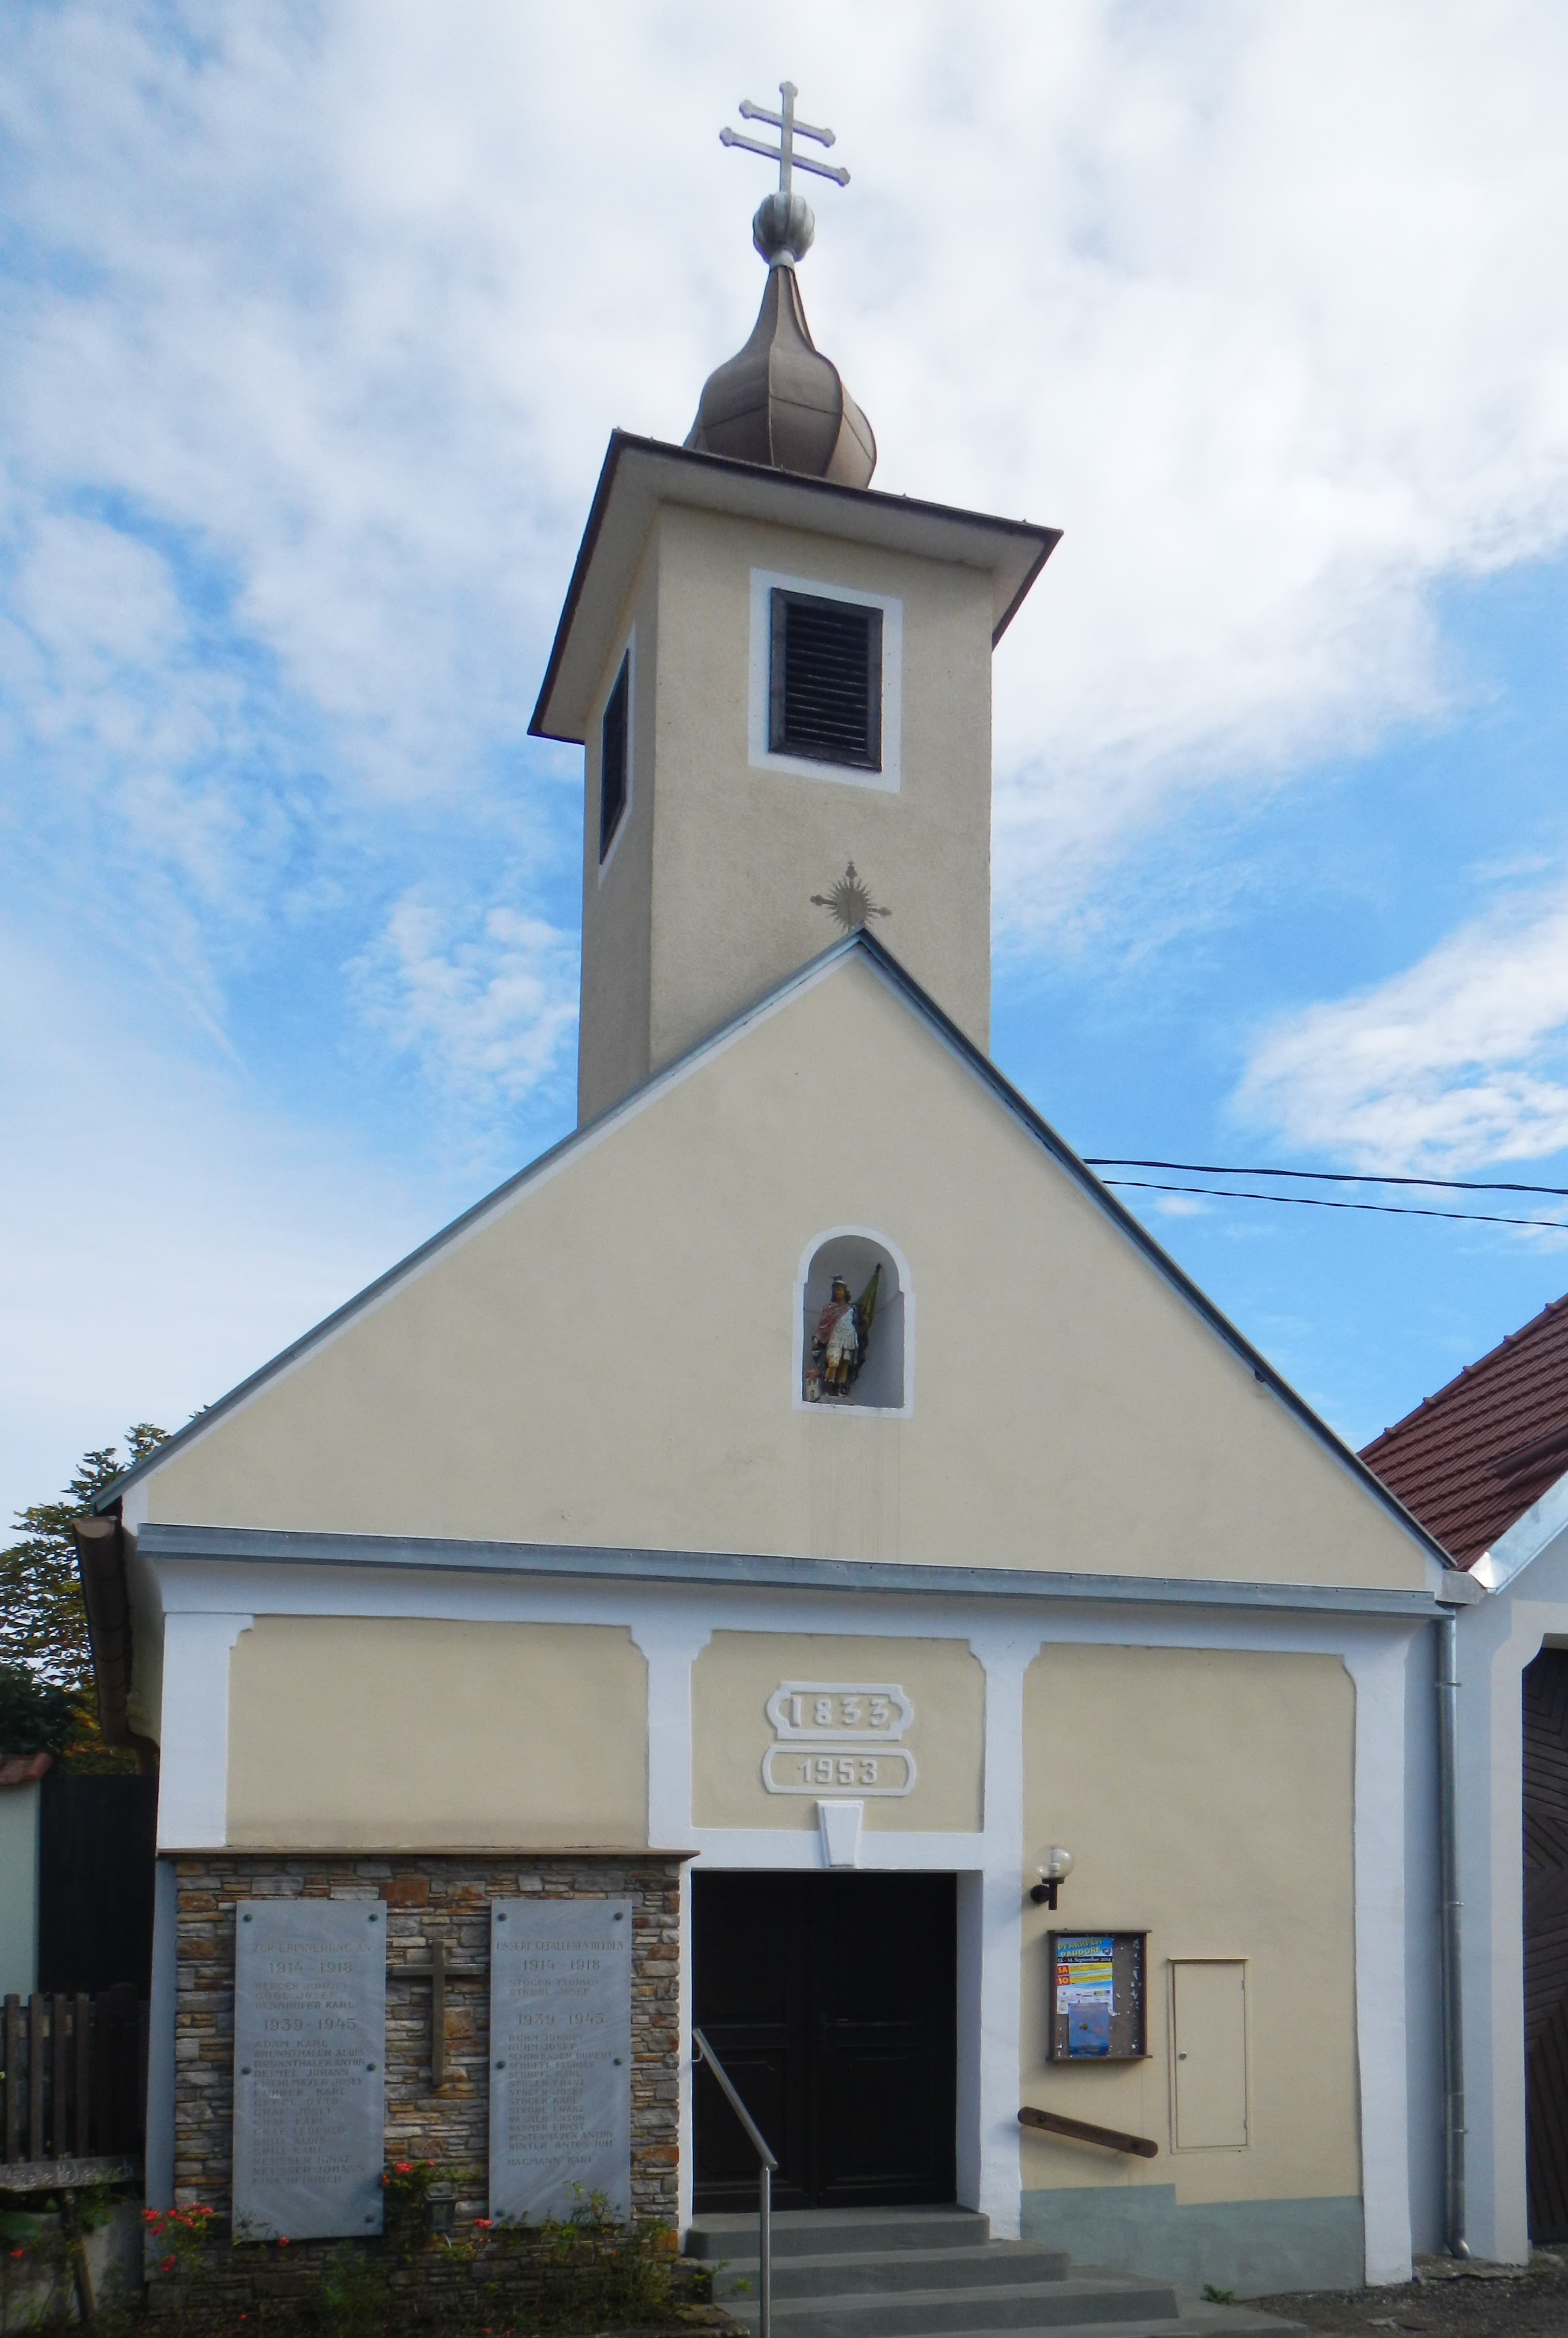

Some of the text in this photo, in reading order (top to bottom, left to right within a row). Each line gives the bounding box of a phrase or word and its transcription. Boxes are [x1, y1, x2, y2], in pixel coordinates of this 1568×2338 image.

[790, 1695, 890, 1727] 1833
[797, 1758, 878, 1784] 1953
[252, 1943, 371, 1954] ZUR ERINNERUNG AN
[496, 1941, 624, 1951] UNSERE GEFALLENEN HELDEN
[1061, 1946, 1101, 1958] PAUDORF
[325, 2001, 355, 2009] KARL
[254, 2040, 328, 2048] ADAM KARL
[336, 2048, 365, 2057] ALOIS
[306, 2069, 349, 2077] JOHANN
[331, 2077, 365, 2086] JOSEF
[315, 2087, 347, 2095] KARL
[552, 2096, 577, 2105] KARL
[552, 2123, 584, 2131] ERNST
[507, 2157, 561, 2166] HAGMANN
